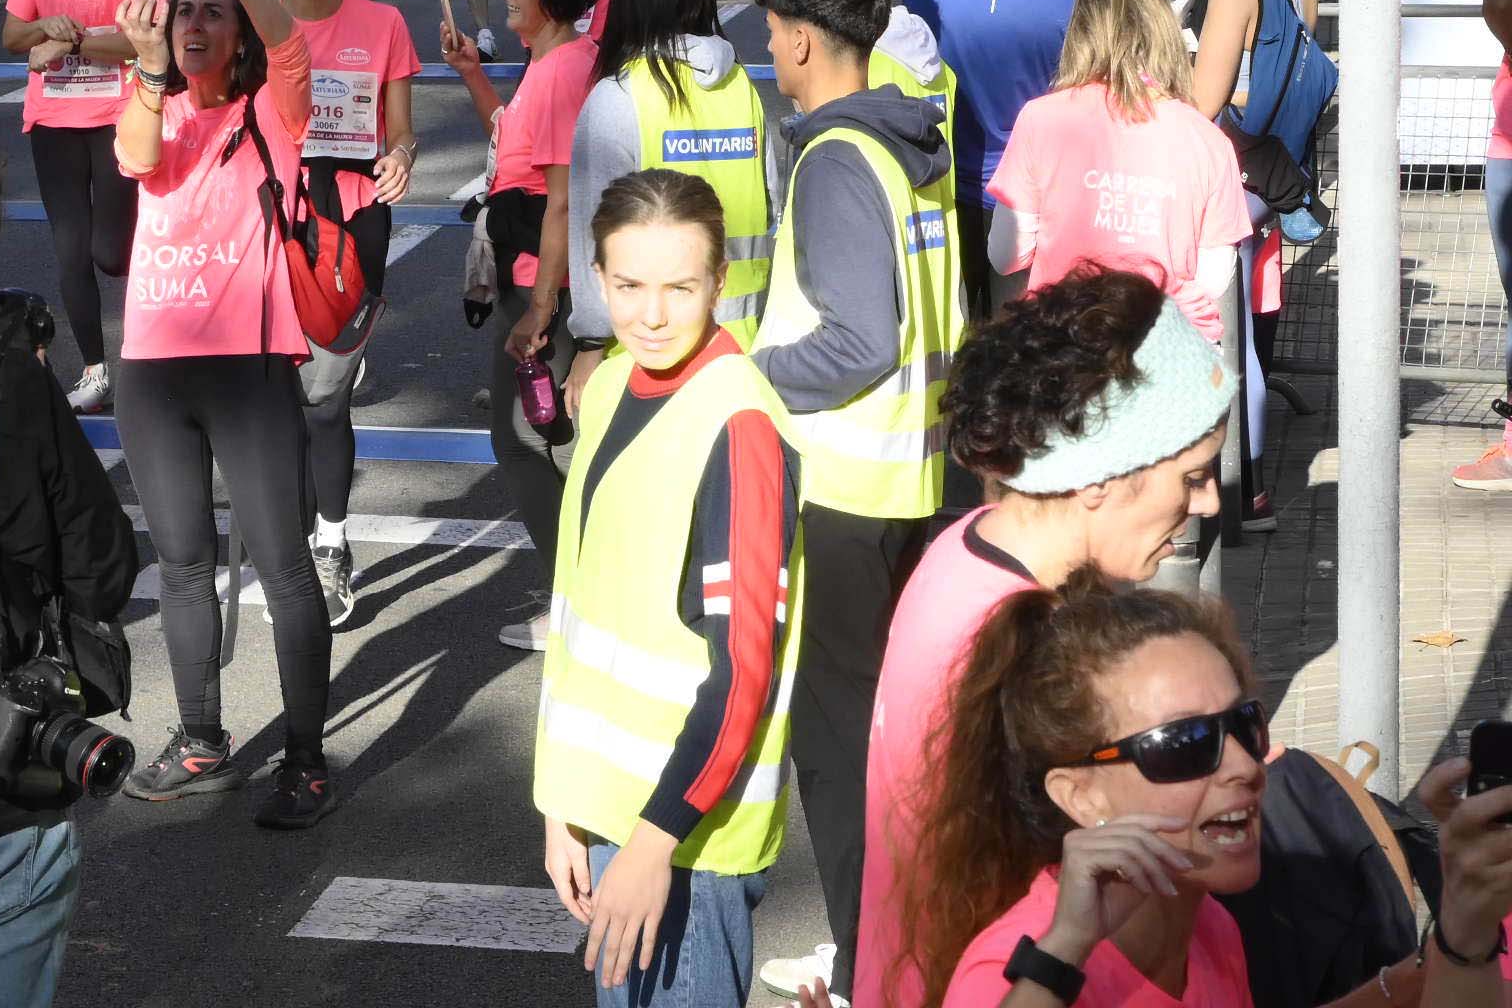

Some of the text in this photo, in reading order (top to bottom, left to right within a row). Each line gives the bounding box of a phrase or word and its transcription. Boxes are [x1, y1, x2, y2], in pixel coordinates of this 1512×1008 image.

[1100, 190, 1128, 211] DE
[135, 240, 240, 270] DORSAL
[135, 274, 209, 302] SUMA
